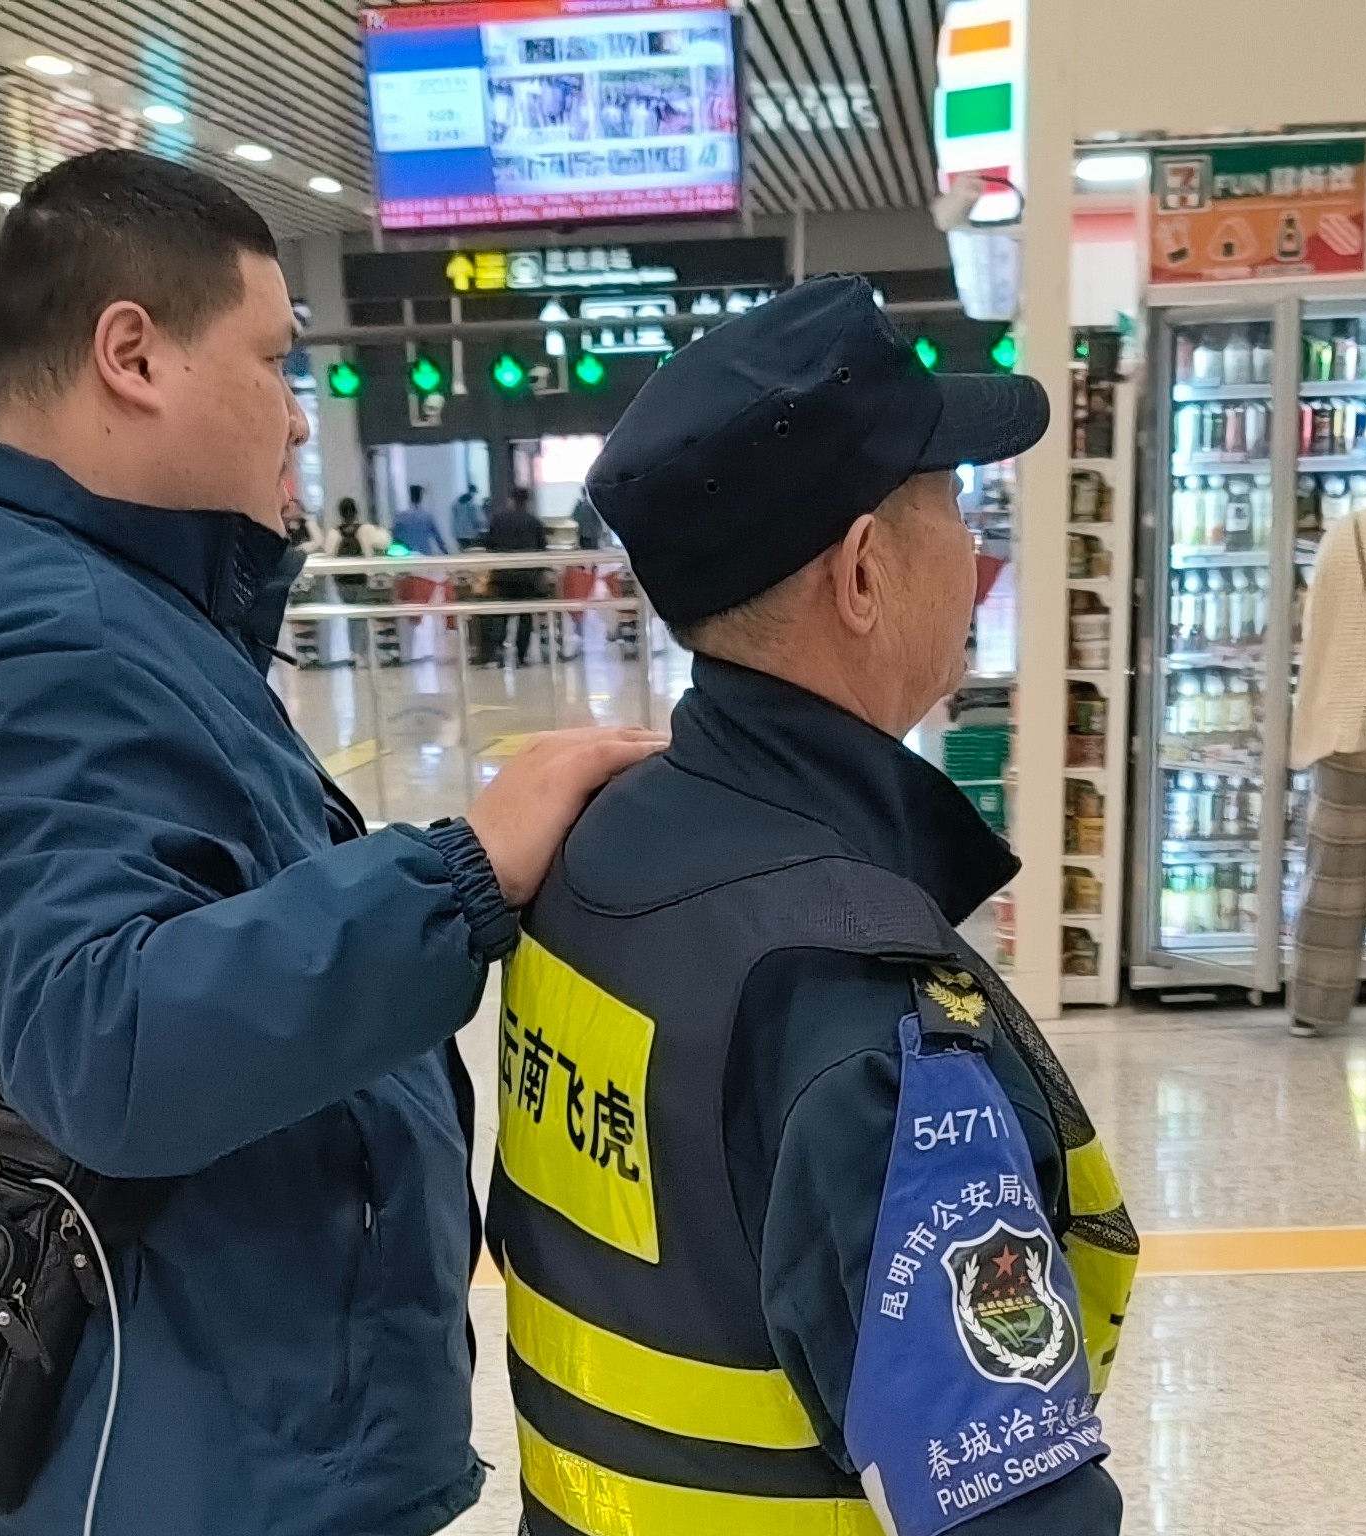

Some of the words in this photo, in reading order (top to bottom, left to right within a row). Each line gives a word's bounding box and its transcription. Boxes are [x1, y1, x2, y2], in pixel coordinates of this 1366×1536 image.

[502, 1006, 640, 1183] 云南飞虎
[936, 1472, 1003, 1516] Public
